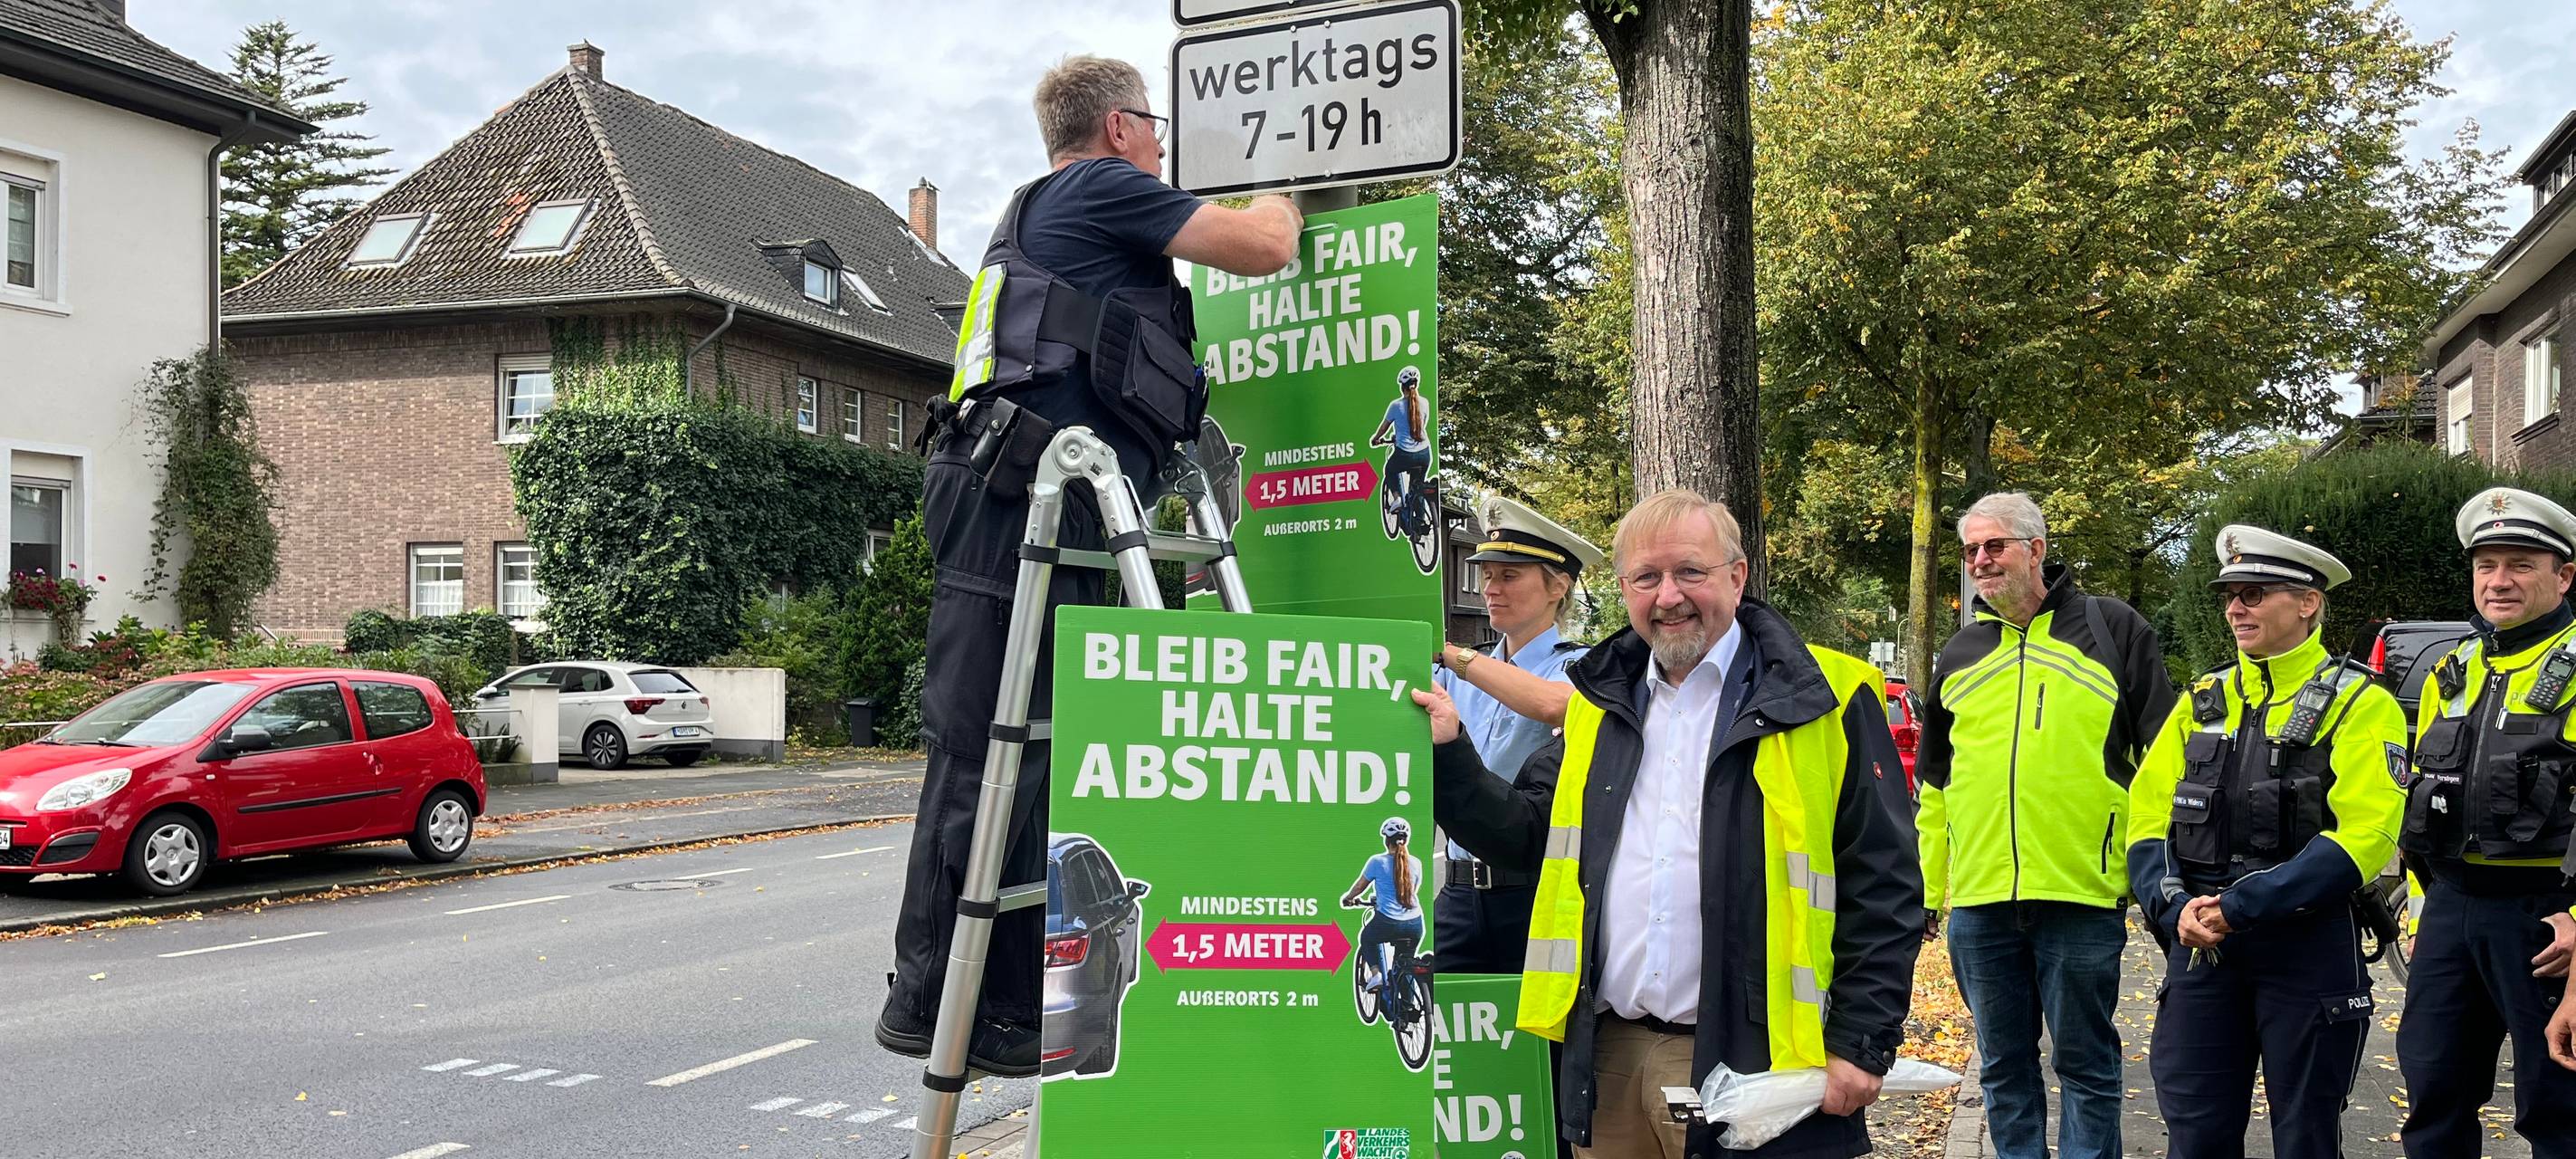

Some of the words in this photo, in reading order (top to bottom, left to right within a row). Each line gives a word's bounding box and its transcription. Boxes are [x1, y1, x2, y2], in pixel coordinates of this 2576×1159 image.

[1190, 33, 1438, 101] werktags
[1241, 101, 1348, 160] 7-19
[1361, 97, 1382, 145] h
[1313, 222, 1418, 271] FAIR,
[1249, 273, 1362, 330] HALTE
[1202, 311, 1421, 386] ABSTAND!
[1264, 442, 1355, 466] MINDESTENS
[1259, 480, 1287, 504] 1,5
[1293, 471, 1360, 497] METER
[1334, 519, 1343, 531] 2
[1345, 521, 1357, 530] m
[1083, 633, 1248, 684] BLEIB
[1267, 640, 1407, 702] FAIR,
[1160, 690, 1333, 742] HALTE
[1071, 742, 1411, 806] ABSTAND!
[1180, 896, 1318, 916] MINDESTENS
[1171, 934, 1215, 962] 1,5
[1224, 934, 1324, 959] METER
[1286, 991, 1297, 1006] 2
[1302, 994, 1319, 1007] m
[1357, 1137, 1410, 1147] VERKEHRS
[1368, 1128, 1410, 1136] LANDES
[1357, 1147, 1393, 1157] WACHT
